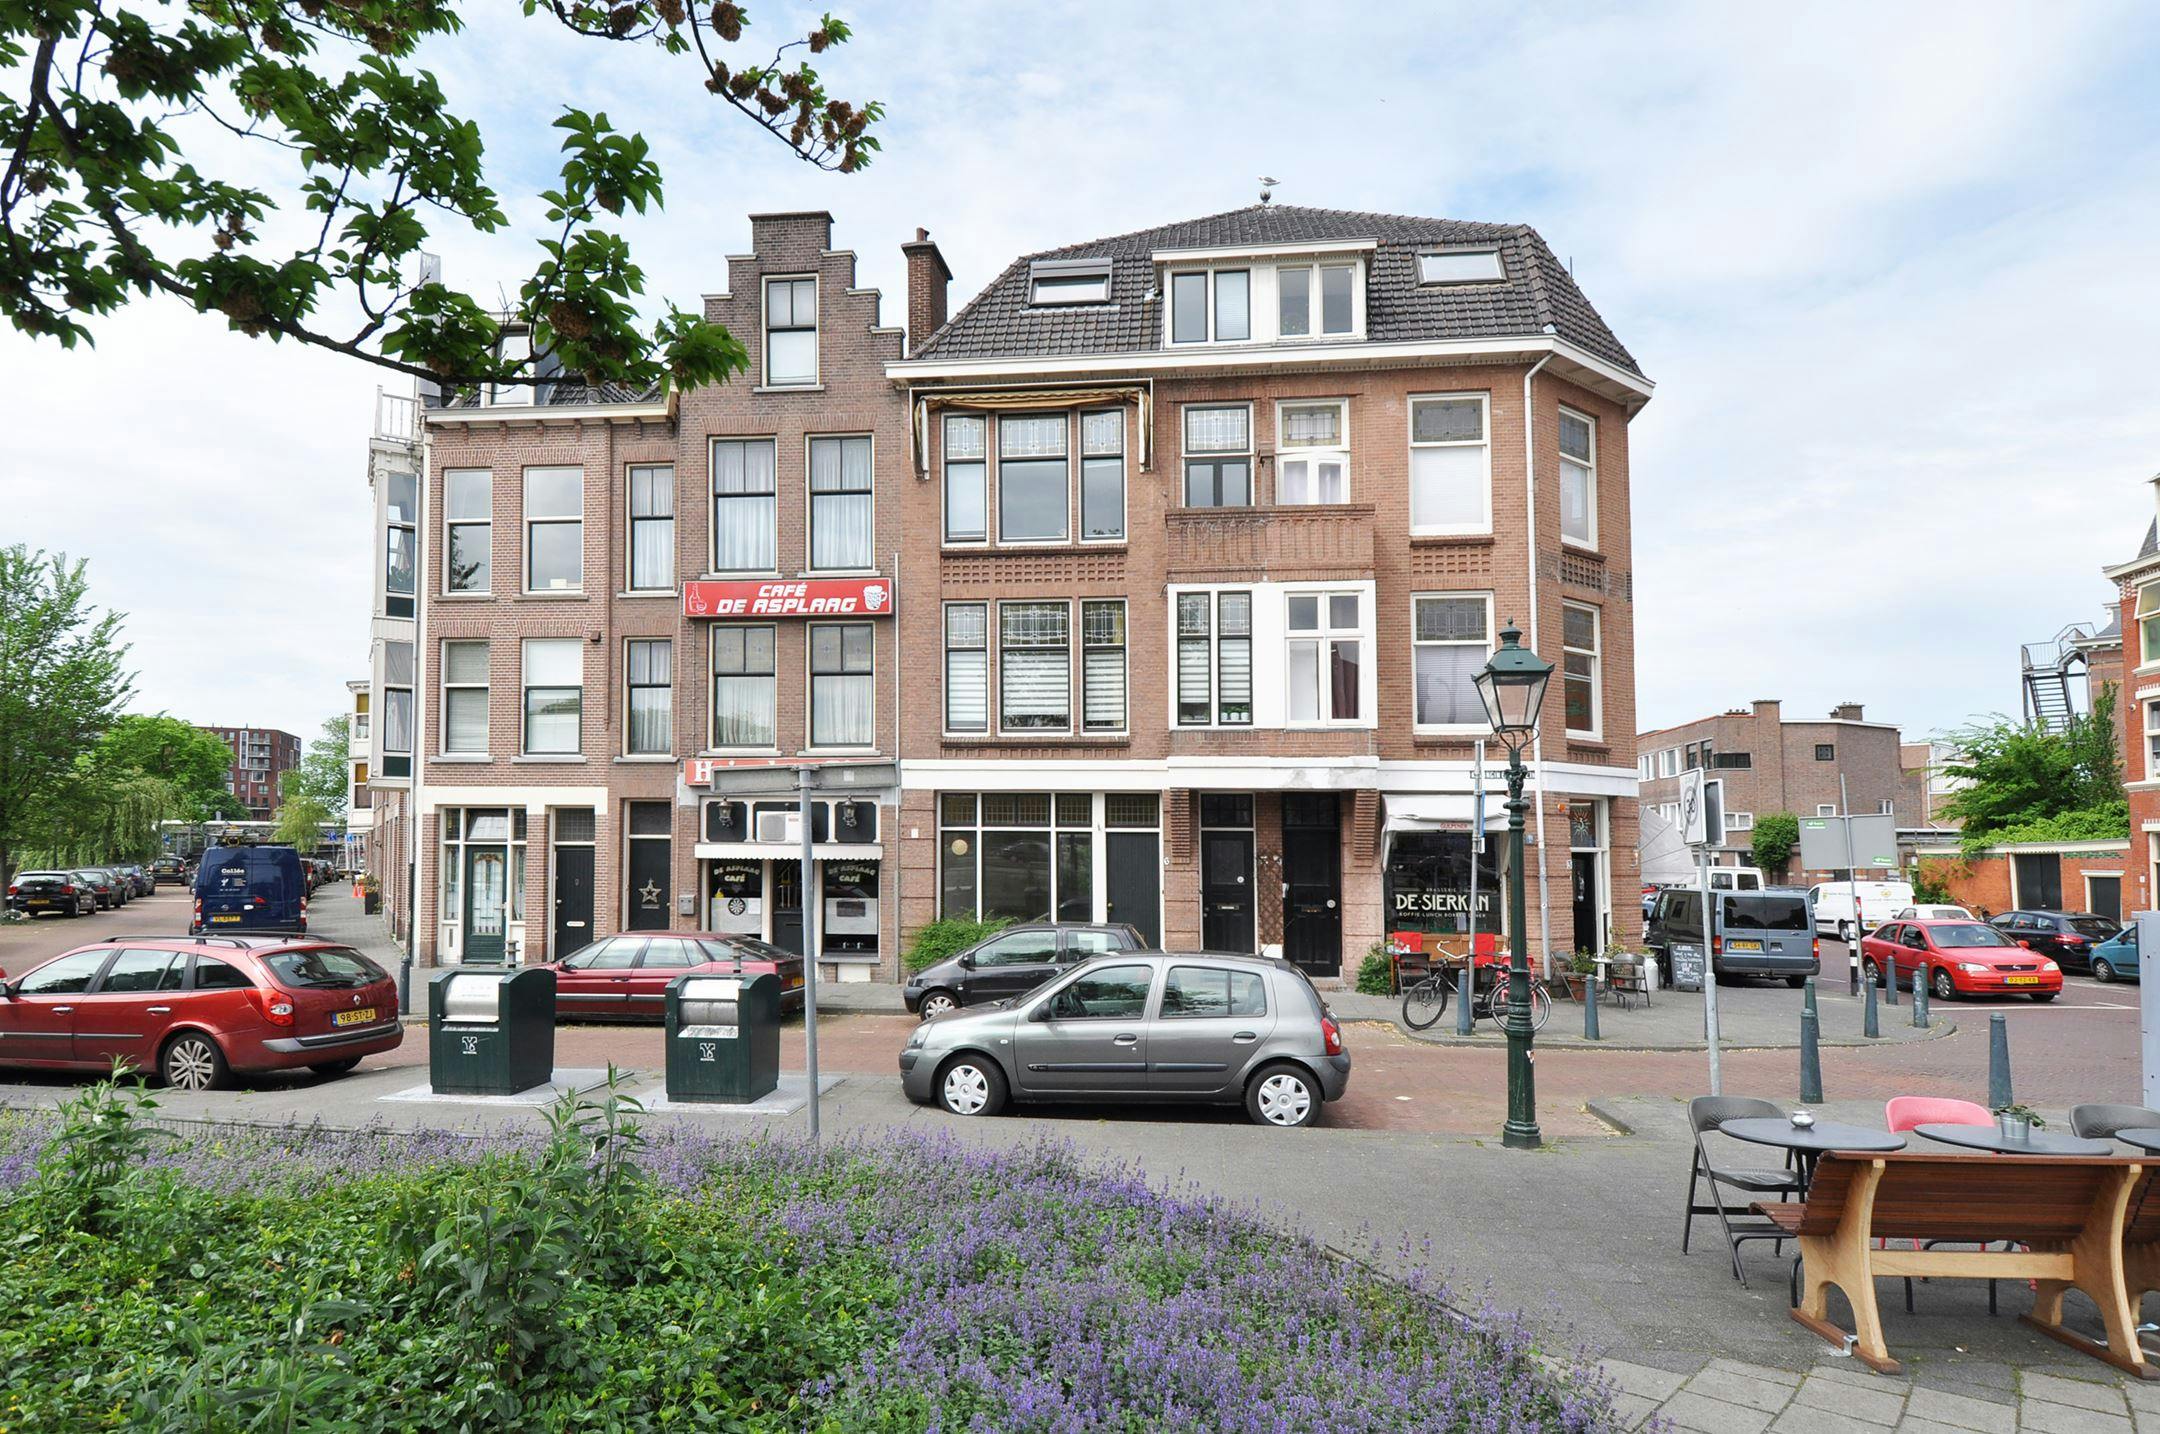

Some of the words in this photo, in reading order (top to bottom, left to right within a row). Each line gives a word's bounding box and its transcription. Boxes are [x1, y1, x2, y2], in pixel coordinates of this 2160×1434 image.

[758, 582, 808, 597] CAFÉ
[716, 598, 747, 614] DE
[751, 597, 858, 614] ASPLAAG
